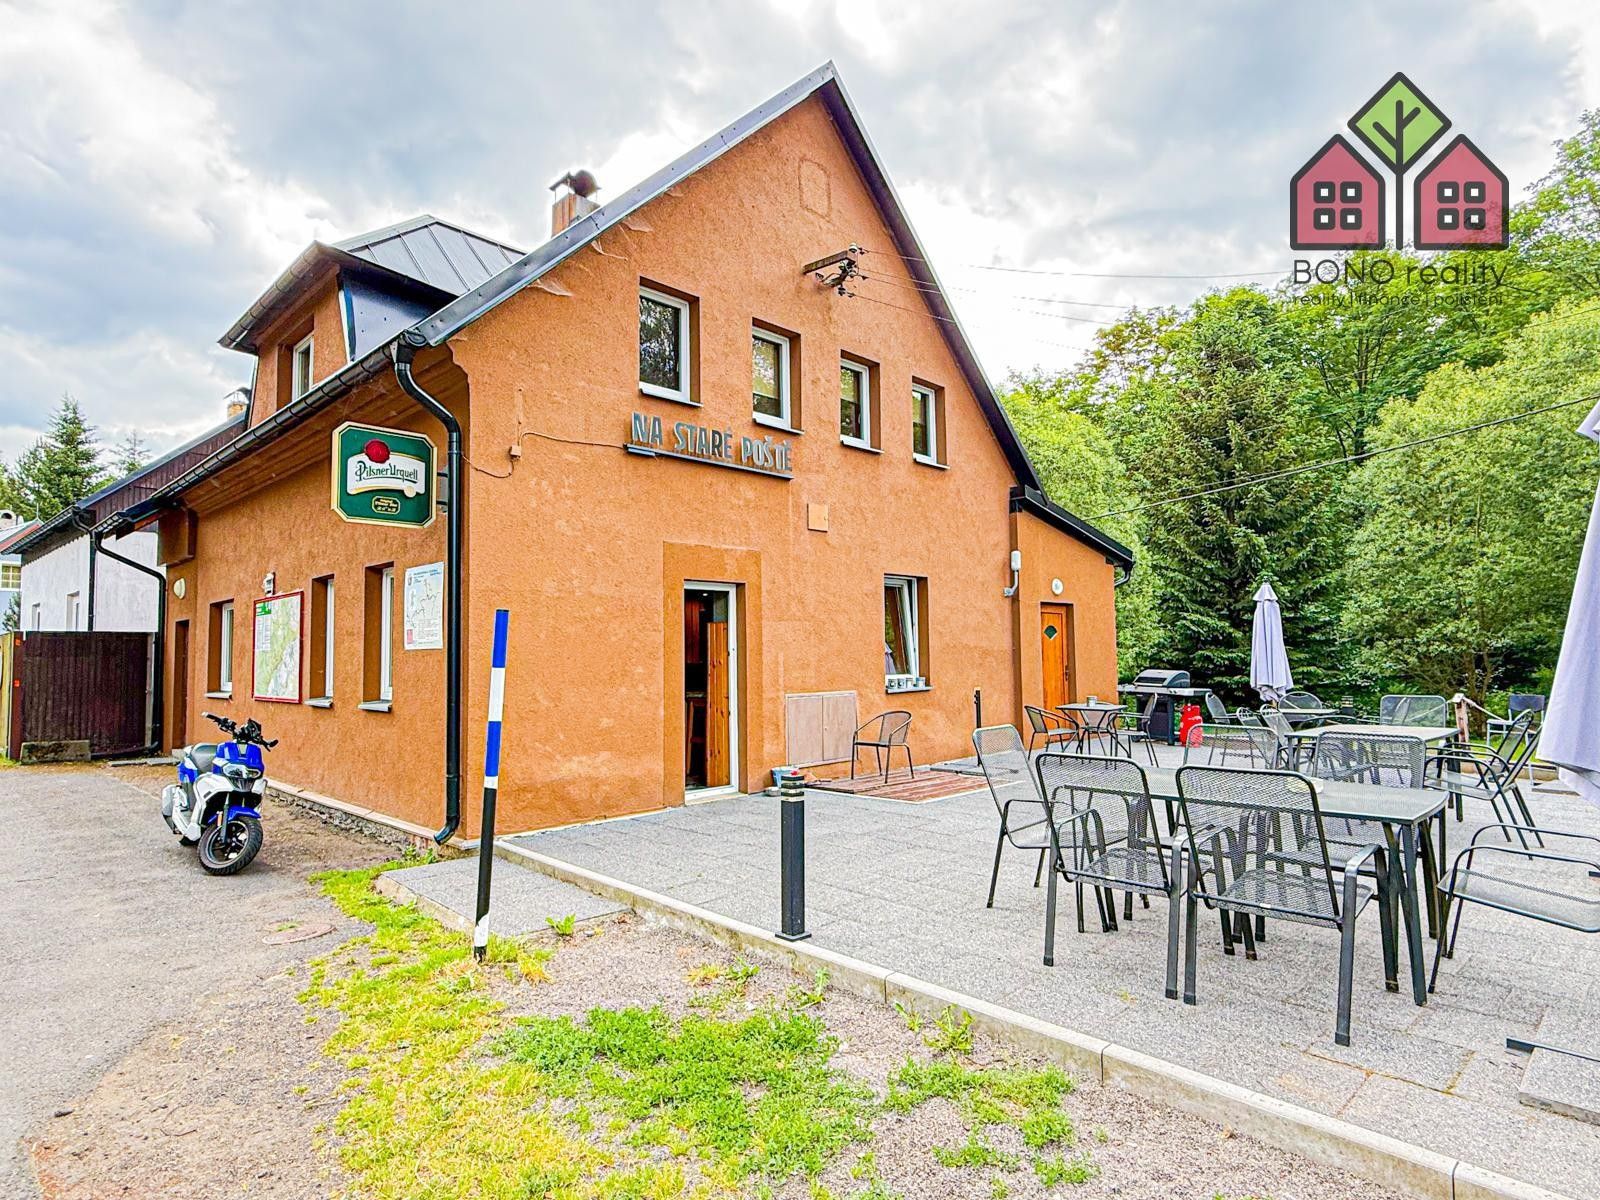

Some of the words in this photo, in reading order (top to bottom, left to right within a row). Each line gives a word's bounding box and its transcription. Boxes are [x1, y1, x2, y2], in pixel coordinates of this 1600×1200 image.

[631, 412, 663, 445] NA
[673, 421, 733, 459] STARÉ
[740, 435, 793, 472] POŠTĚ
[355, 460, 390, 482] Pilsner
[389, 463, 418, 484] Urquell
